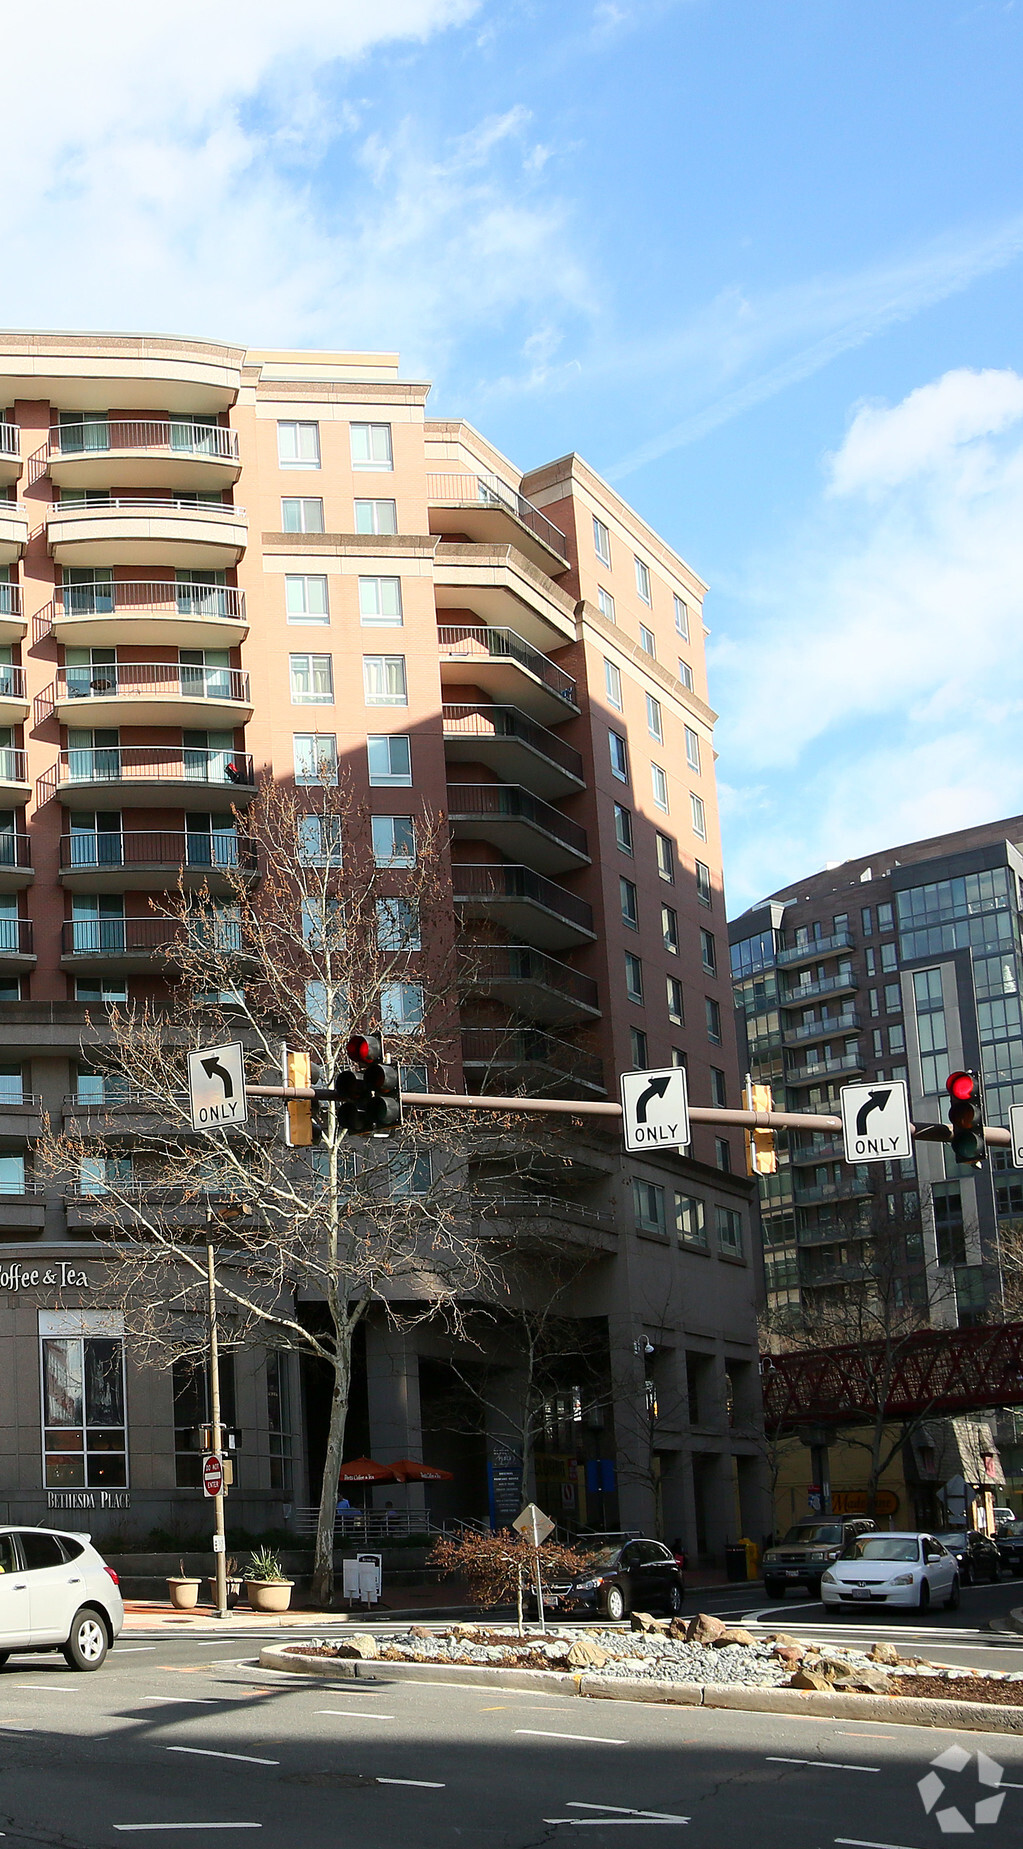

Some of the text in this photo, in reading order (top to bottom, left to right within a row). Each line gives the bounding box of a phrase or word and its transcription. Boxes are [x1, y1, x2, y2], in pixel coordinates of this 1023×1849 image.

[199, 1101, 238, 1122] ONLY
[635, 1123, 678, 1143] ONLY
[855, 1136, 900, 1154] ONLY
[42, 1269, 57, 1284] &
[54, 1261, 89, 1287] Tea
[207, 1480, 219, 1489] ENTER
[47, 1491, 131, 1509] BETHESDA PLACE
